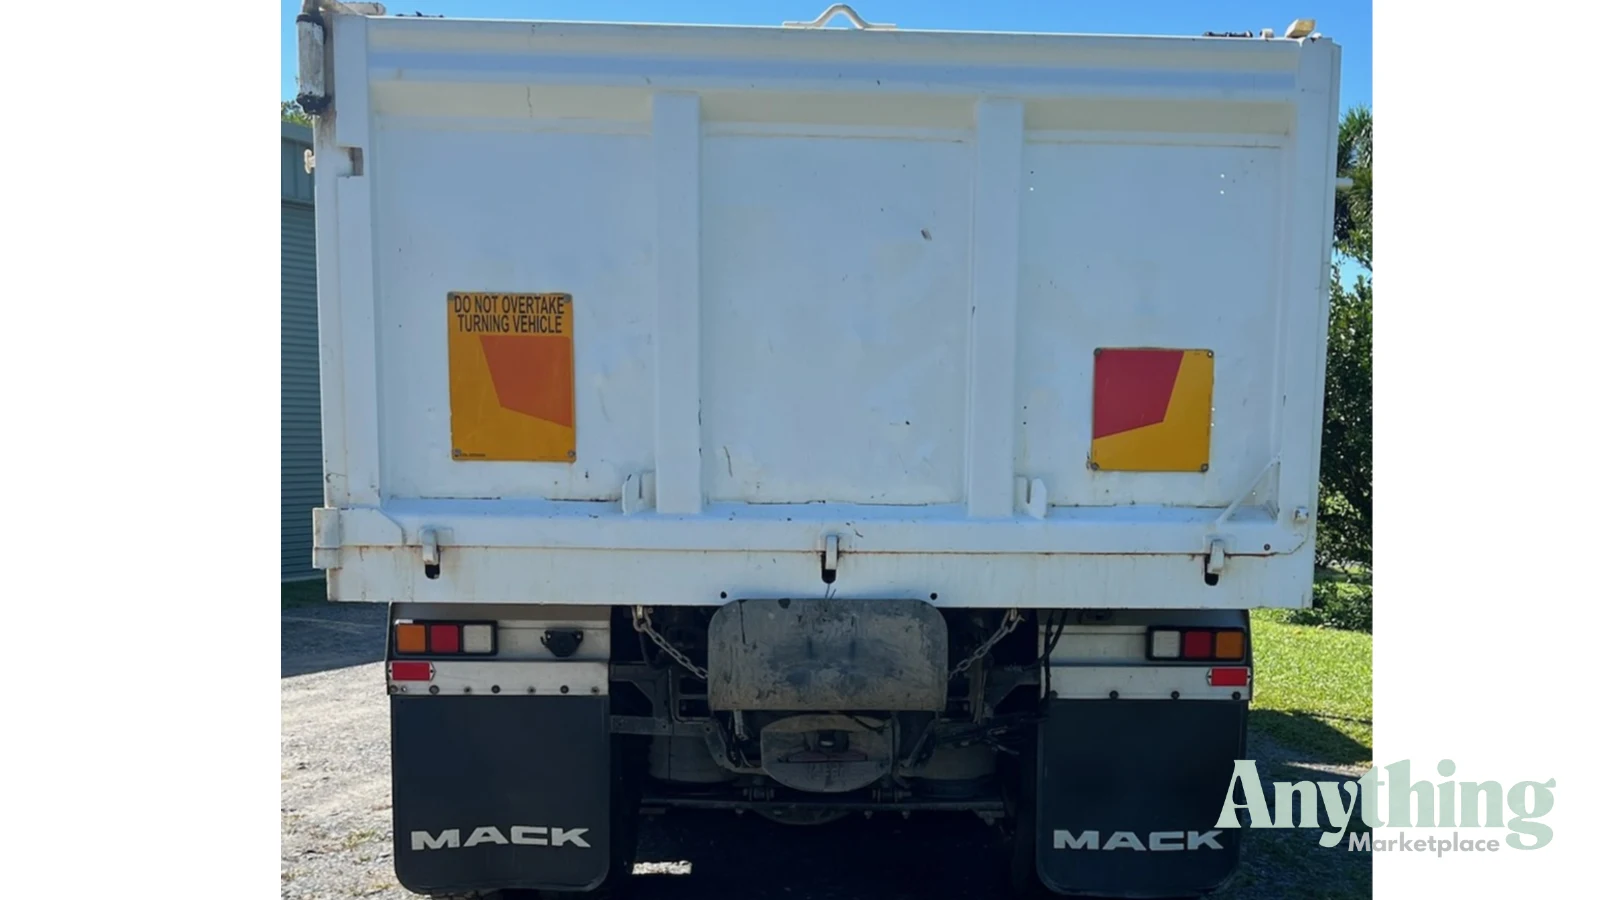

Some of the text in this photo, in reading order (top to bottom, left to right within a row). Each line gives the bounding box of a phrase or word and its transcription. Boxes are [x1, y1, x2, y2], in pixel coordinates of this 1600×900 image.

[454, 295, 564, 314] DO NOT OVERTAKE
[458, 314, 562, 333] TURNING VEHICLE
[411, 826, 591, 850] MACK
[1053, 829, 1224, 851] MACK
